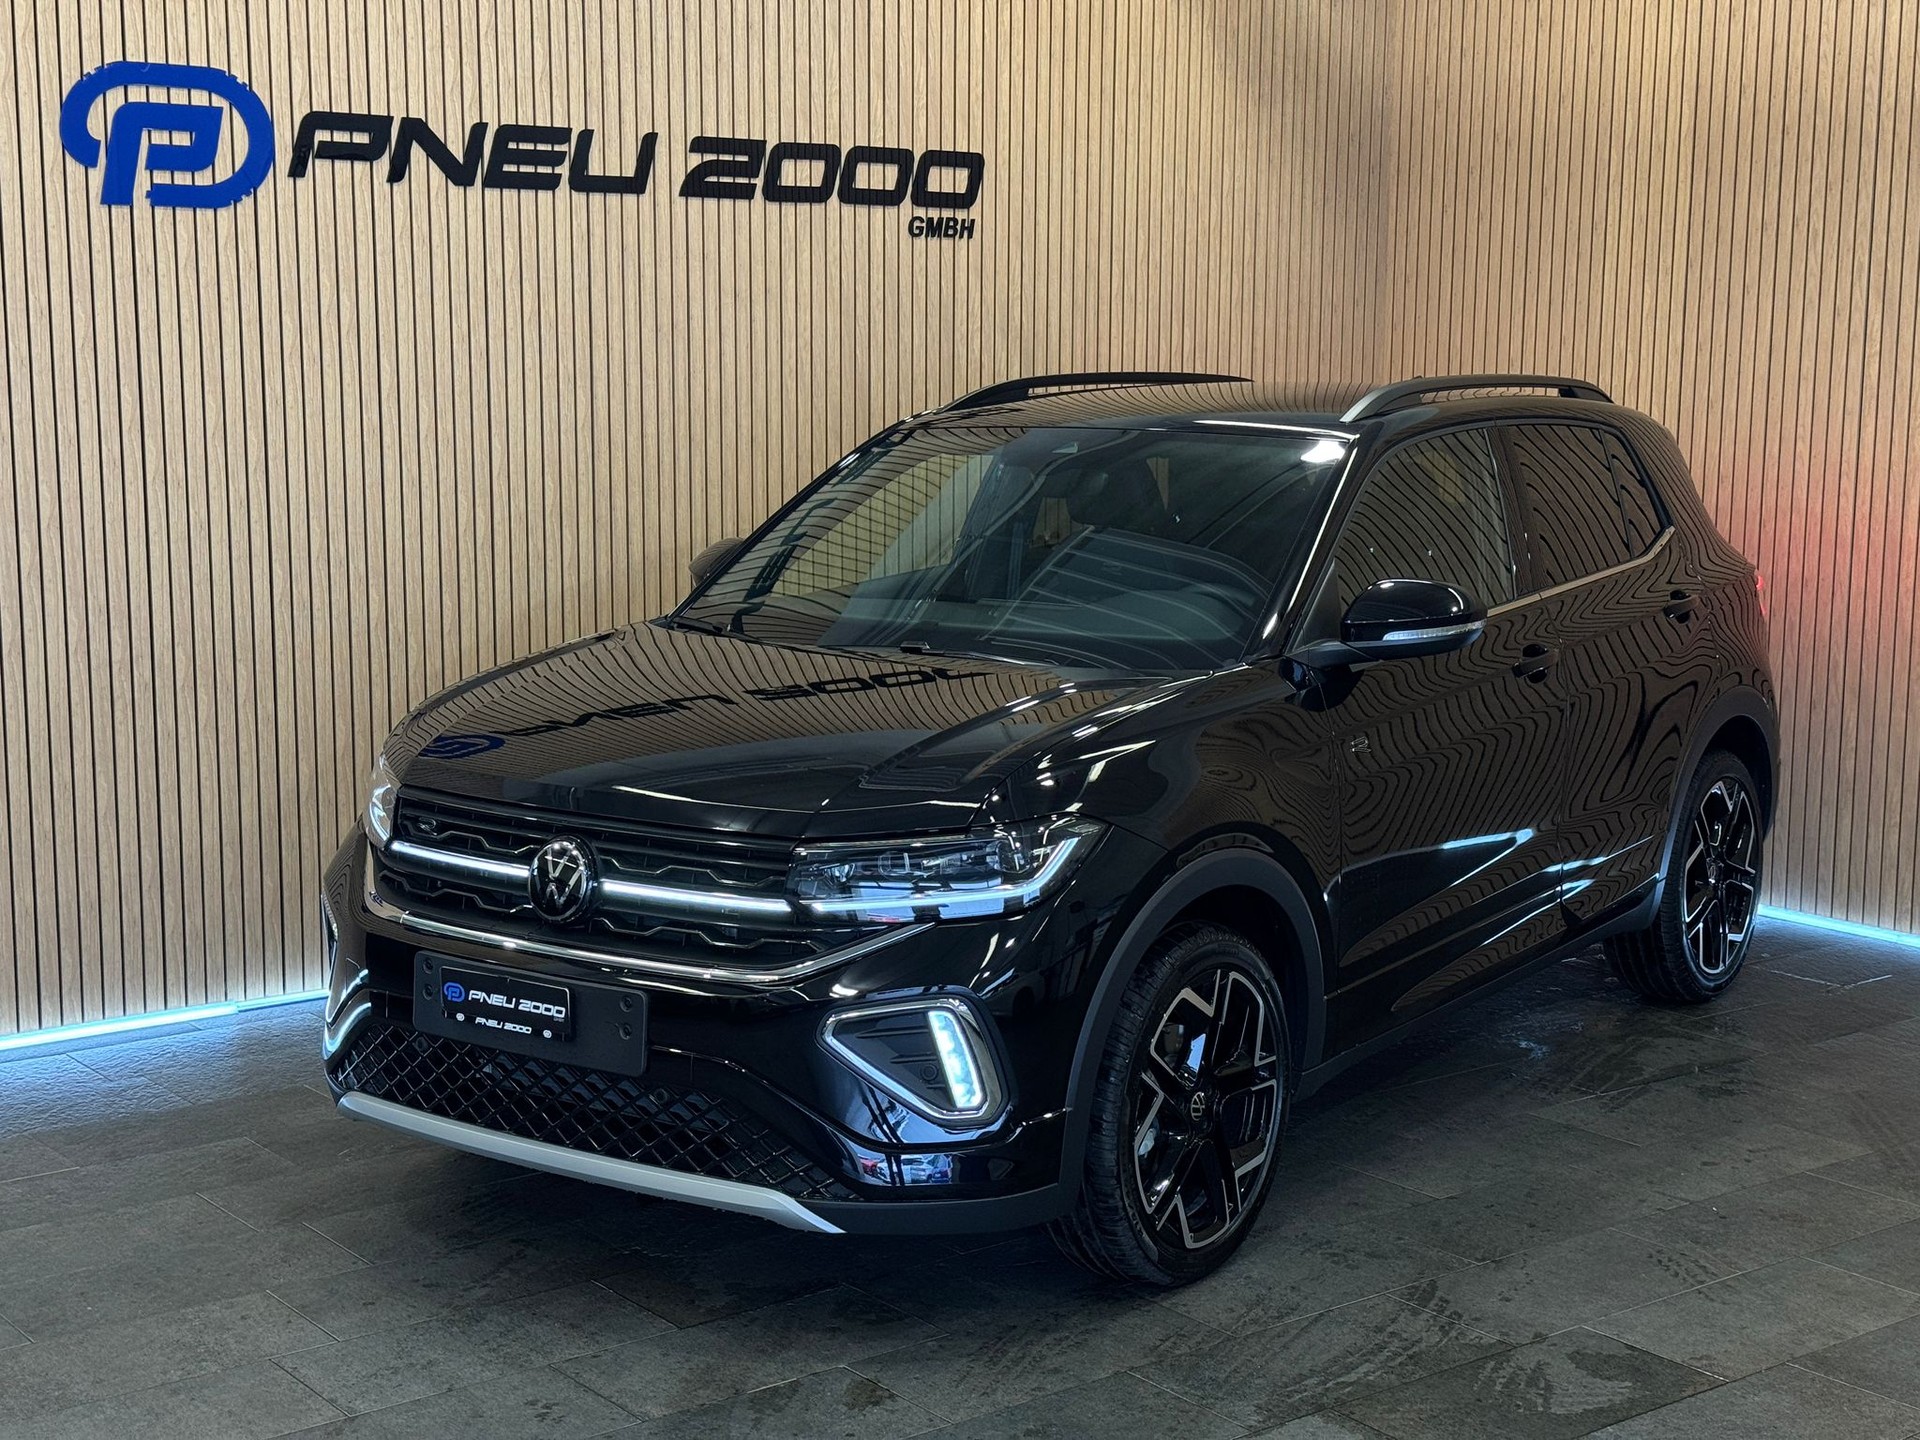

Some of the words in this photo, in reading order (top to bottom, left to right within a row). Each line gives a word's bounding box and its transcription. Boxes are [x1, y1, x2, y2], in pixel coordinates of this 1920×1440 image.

[287, 110, 659, 195] PNEU
[679, 135, 986, 209] 2000
[907, 216, 976, 239] GMBH
[468, 990, 516, 1009] PNEU
[518, 999, 566, 1018] 2000
[475, 1016, 503, 1029] PNEU
[504, 1022, 532, 1035] 2000
